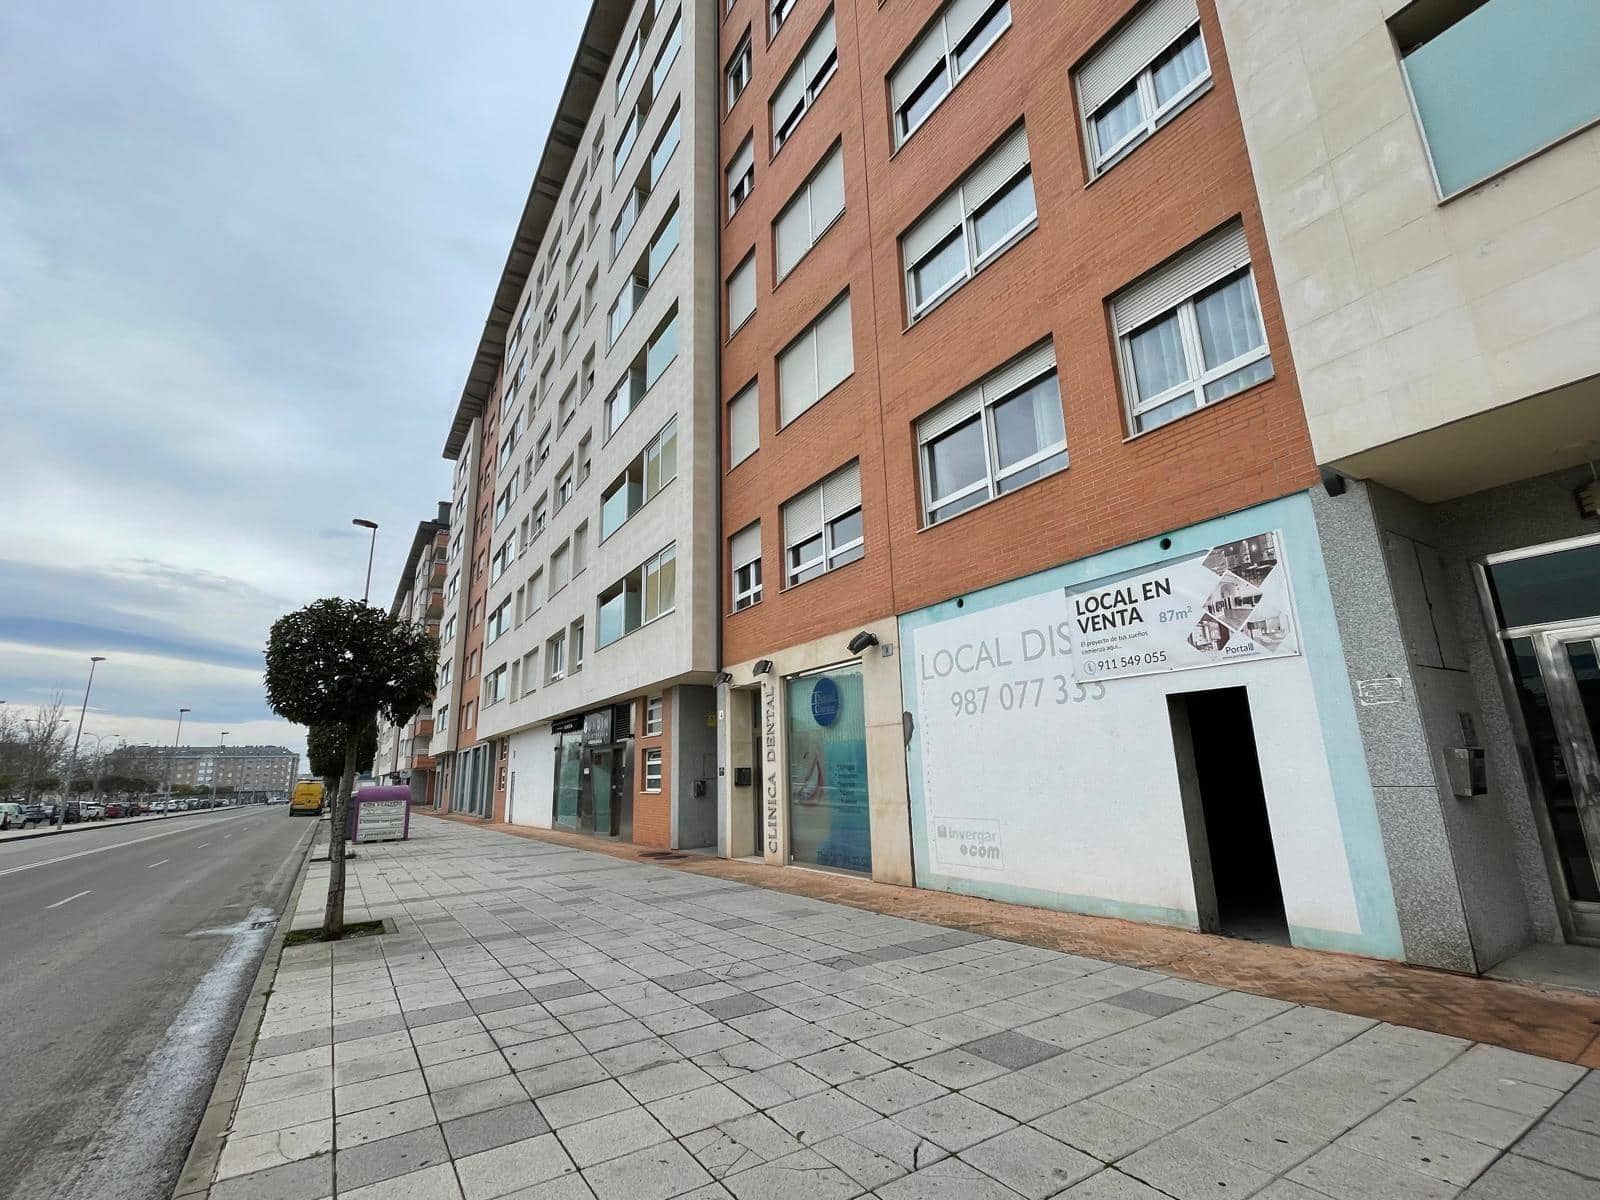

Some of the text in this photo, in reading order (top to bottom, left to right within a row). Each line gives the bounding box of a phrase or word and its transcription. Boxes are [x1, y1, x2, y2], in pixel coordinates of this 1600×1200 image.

[1076, 578, 1171, 616] LOCAL EN
[1077, 607, 1144, 634] VENTA
[921, 637, 1012, 681] LOCAL
[1086, 638, 1109, 647] proyecto
[1097, 650, 1167, 671] 911 549 055
[951, 686, 990, 717] 987
[1000, 678, 1045, 711] 077
[765, 685, 776, 762] DENTAL
